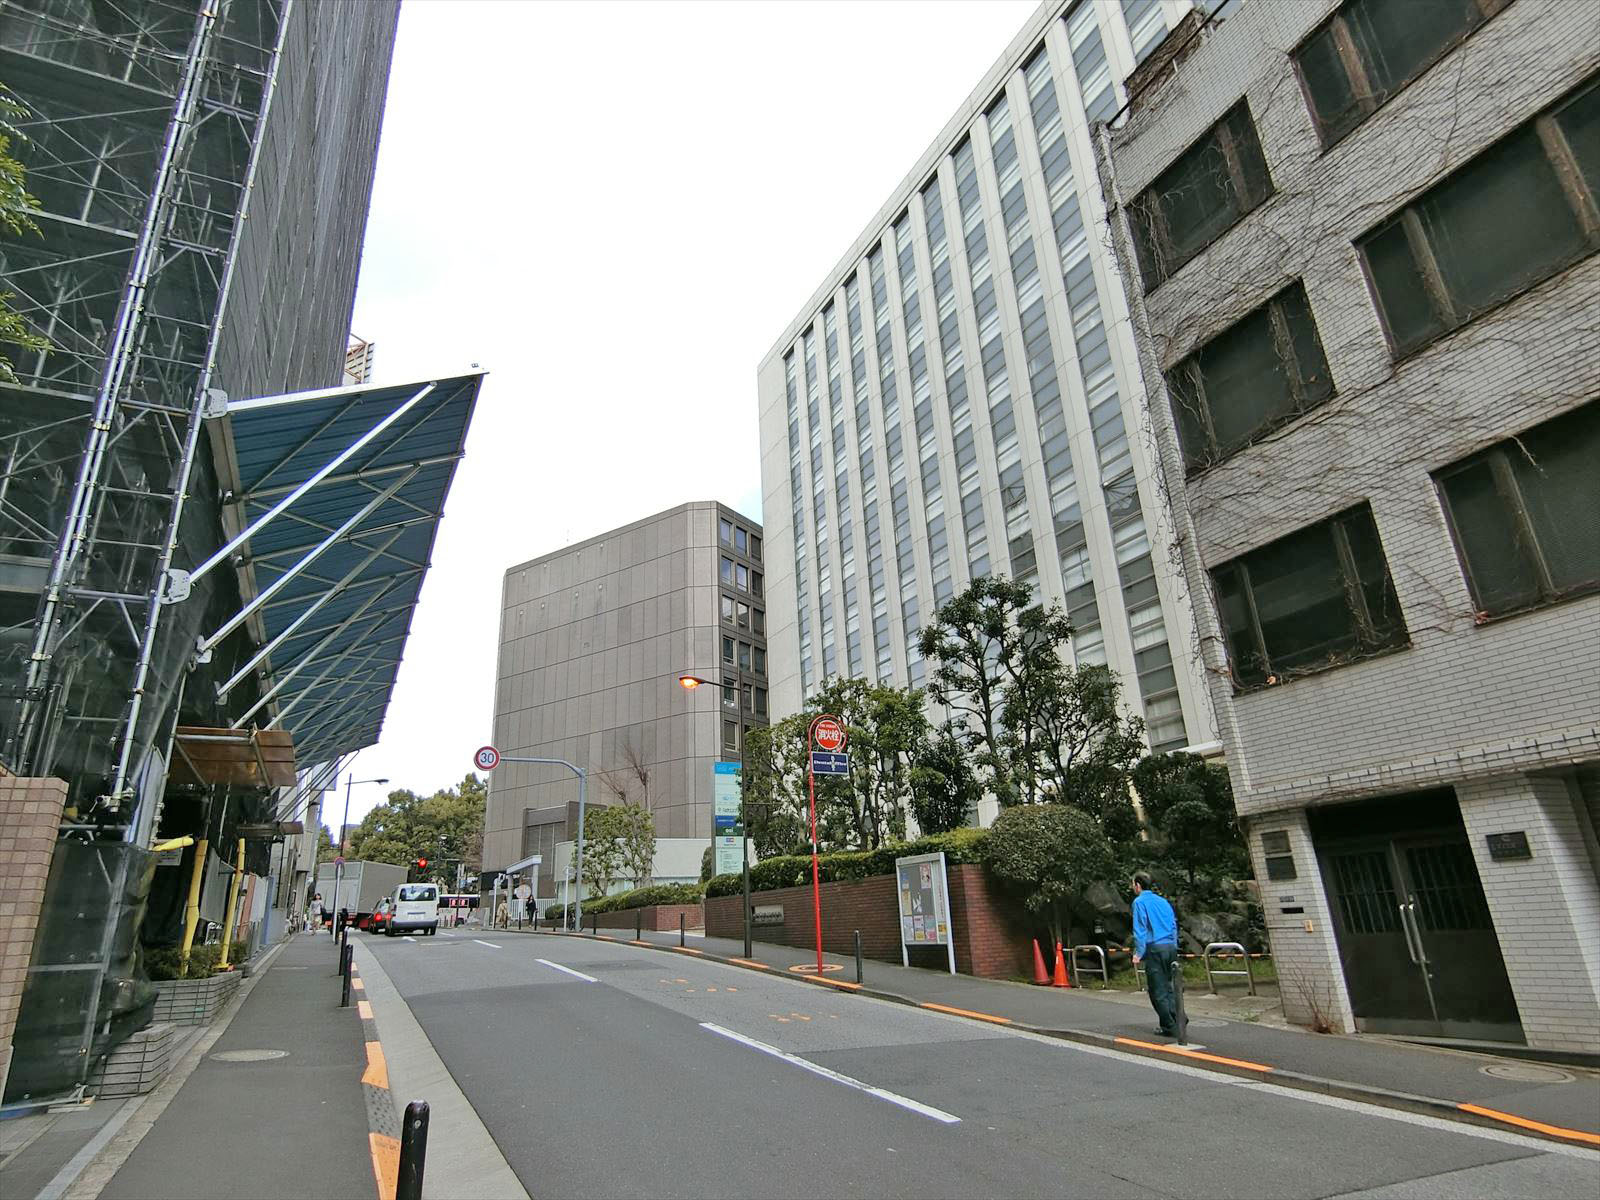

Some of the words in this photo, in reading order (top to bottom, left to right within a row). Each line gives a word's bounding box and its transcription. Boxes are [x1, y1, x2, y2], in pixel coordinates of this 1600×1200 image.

[818, 729, 840, 741] 消火栓
[480, 752, 494, 764] 30
